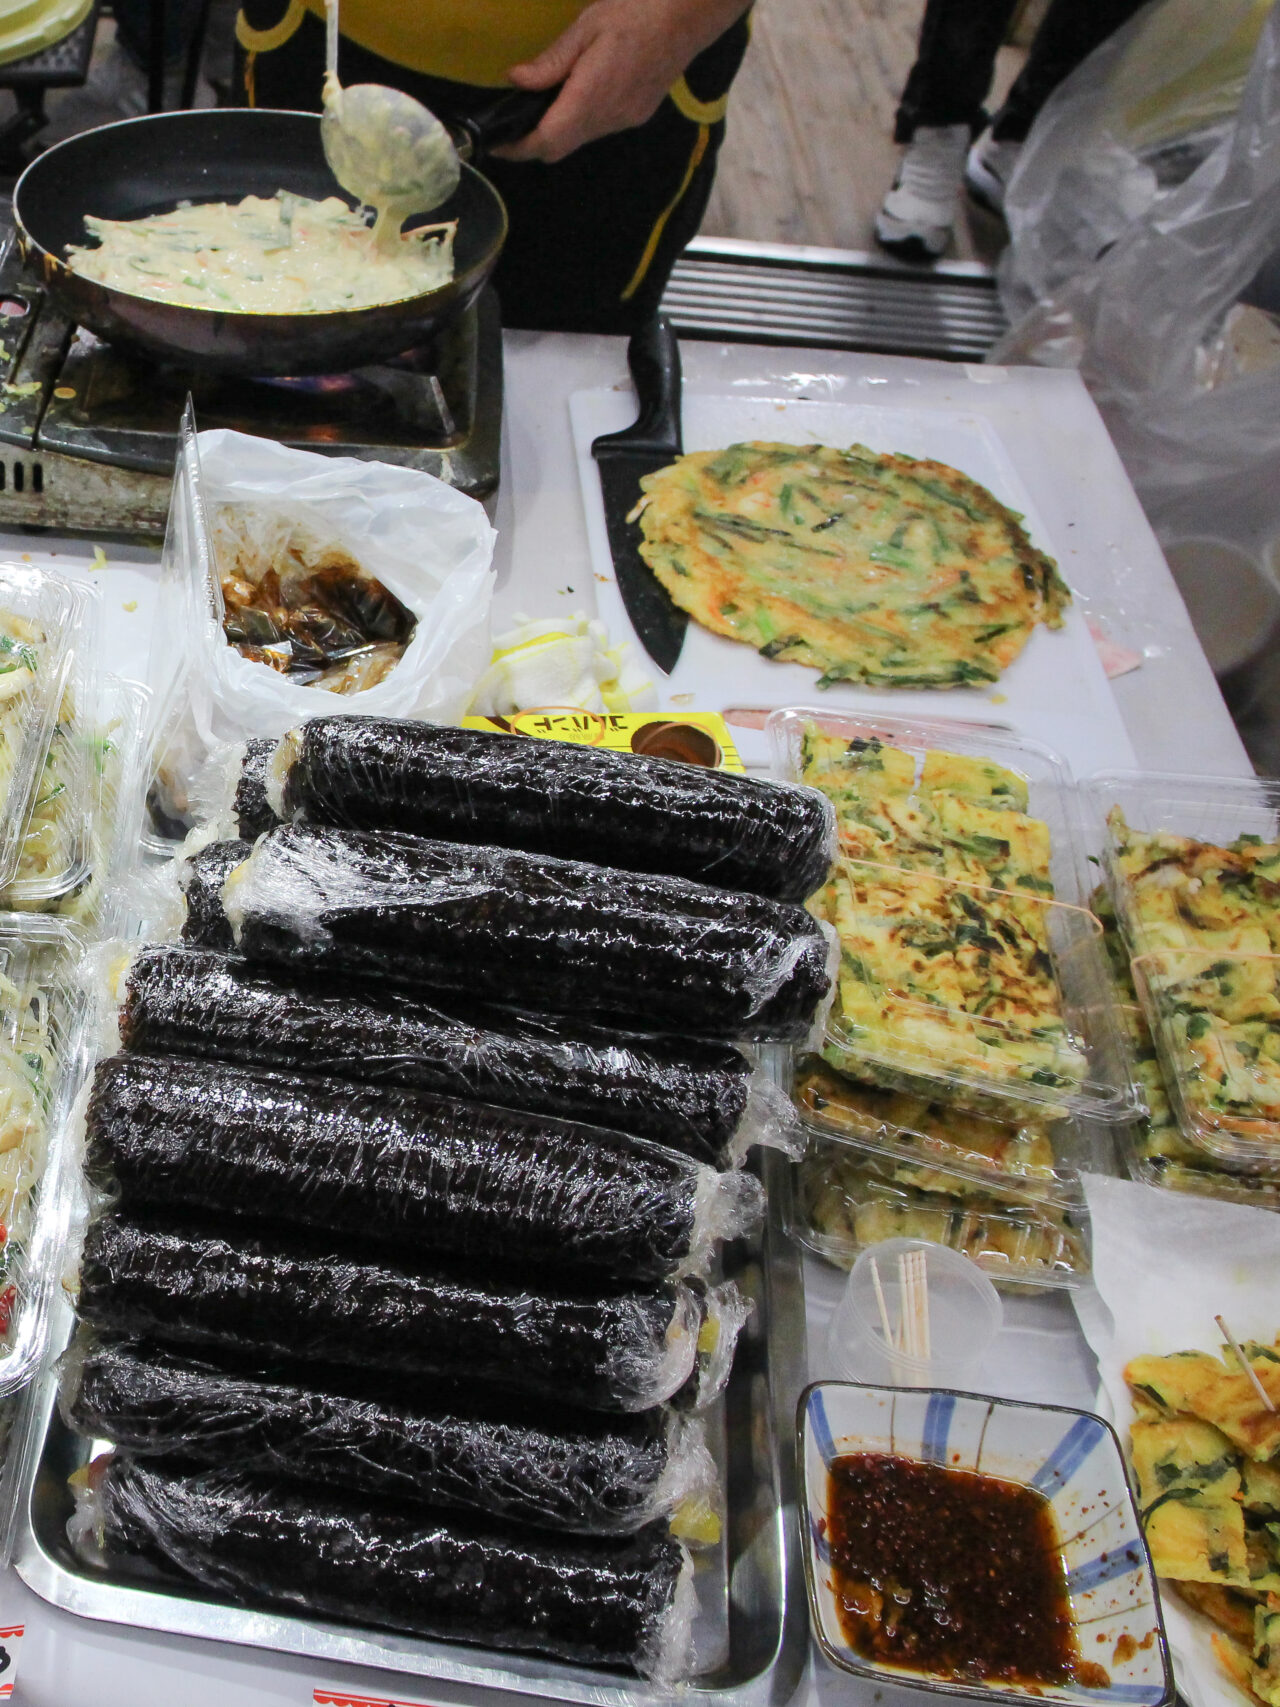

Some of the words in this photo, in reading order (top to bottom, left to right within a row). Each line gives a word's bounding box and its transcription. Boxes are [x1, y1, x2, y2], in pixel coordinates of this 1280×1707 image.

[533, 715, 629, 733] ゴムバンド
